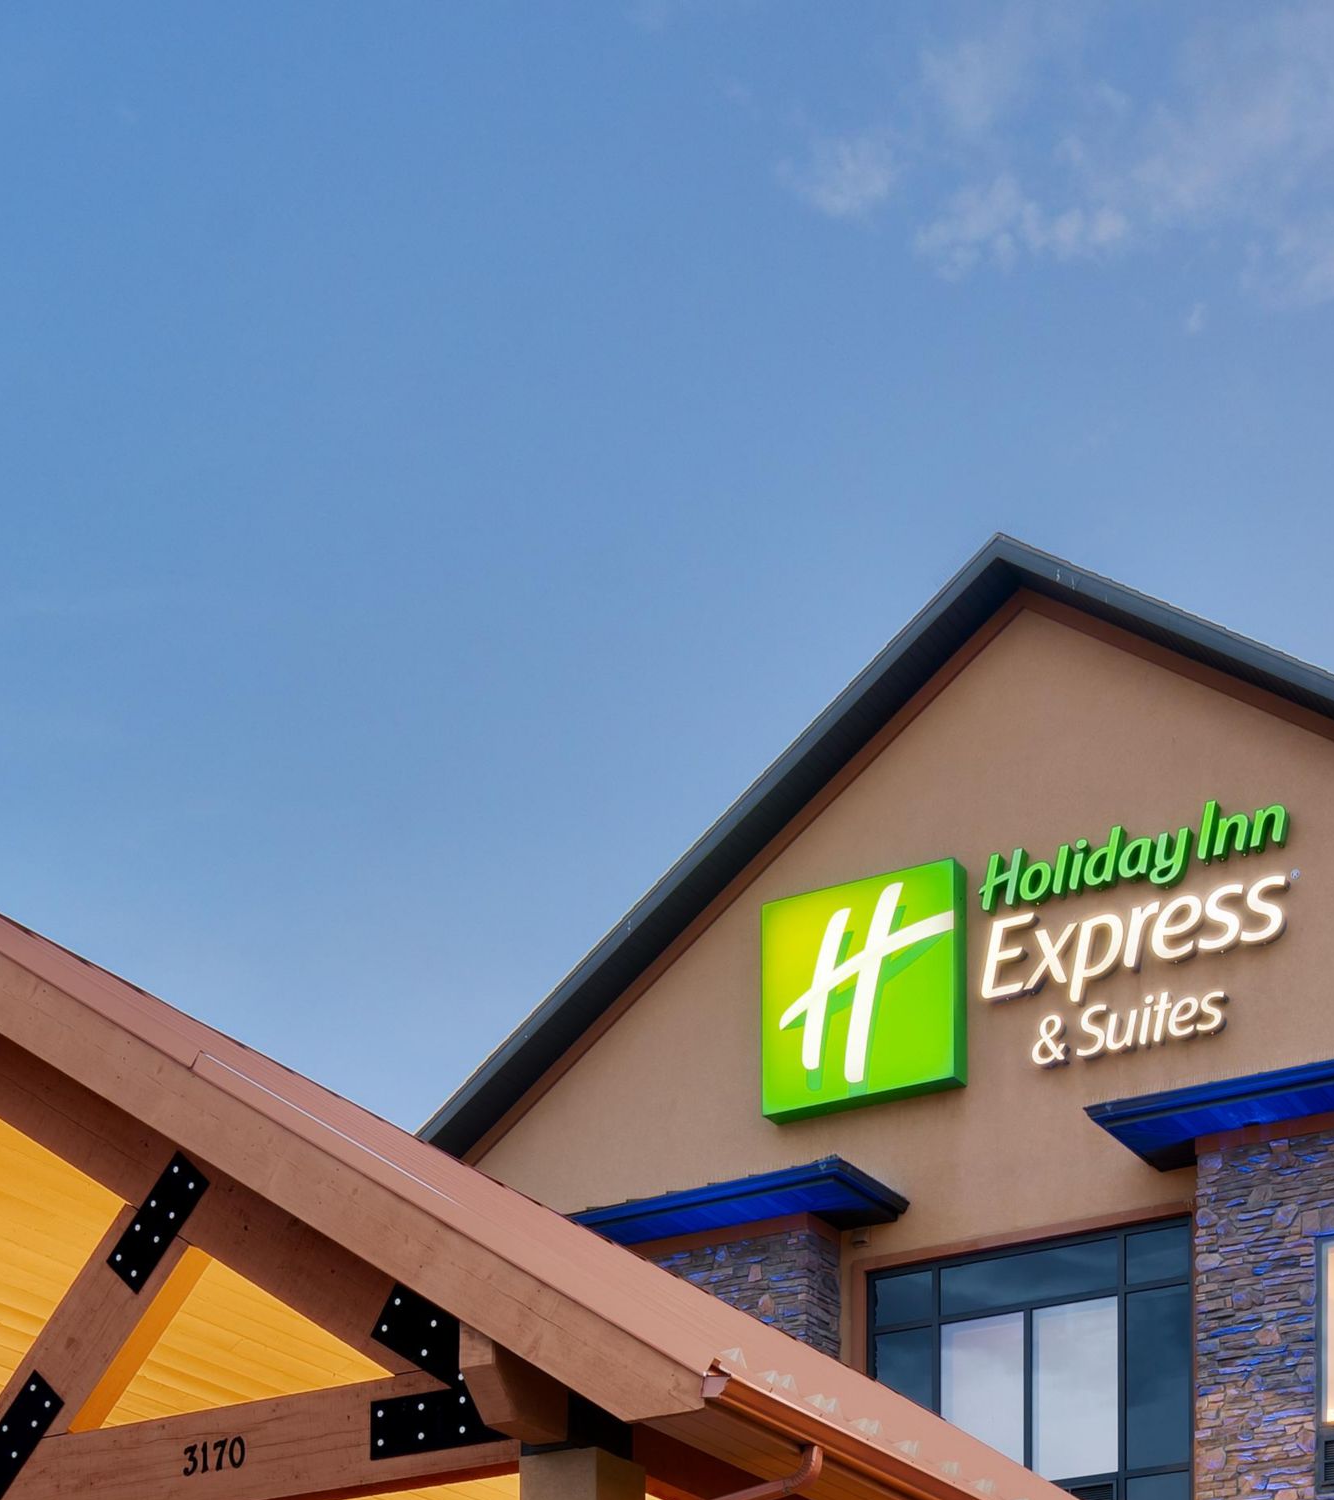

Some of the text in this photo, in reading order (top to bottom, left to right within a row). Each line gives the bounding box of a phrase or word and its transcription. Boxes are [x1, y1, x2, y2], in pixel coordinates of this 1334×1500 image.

[979, 799, 1289, 914] Holiday Inn
[980, 874, 1289, 1003] Express
[1031, 991, 1227, 1066] & Suites
[182, 1435, 246, 1477] 3170
